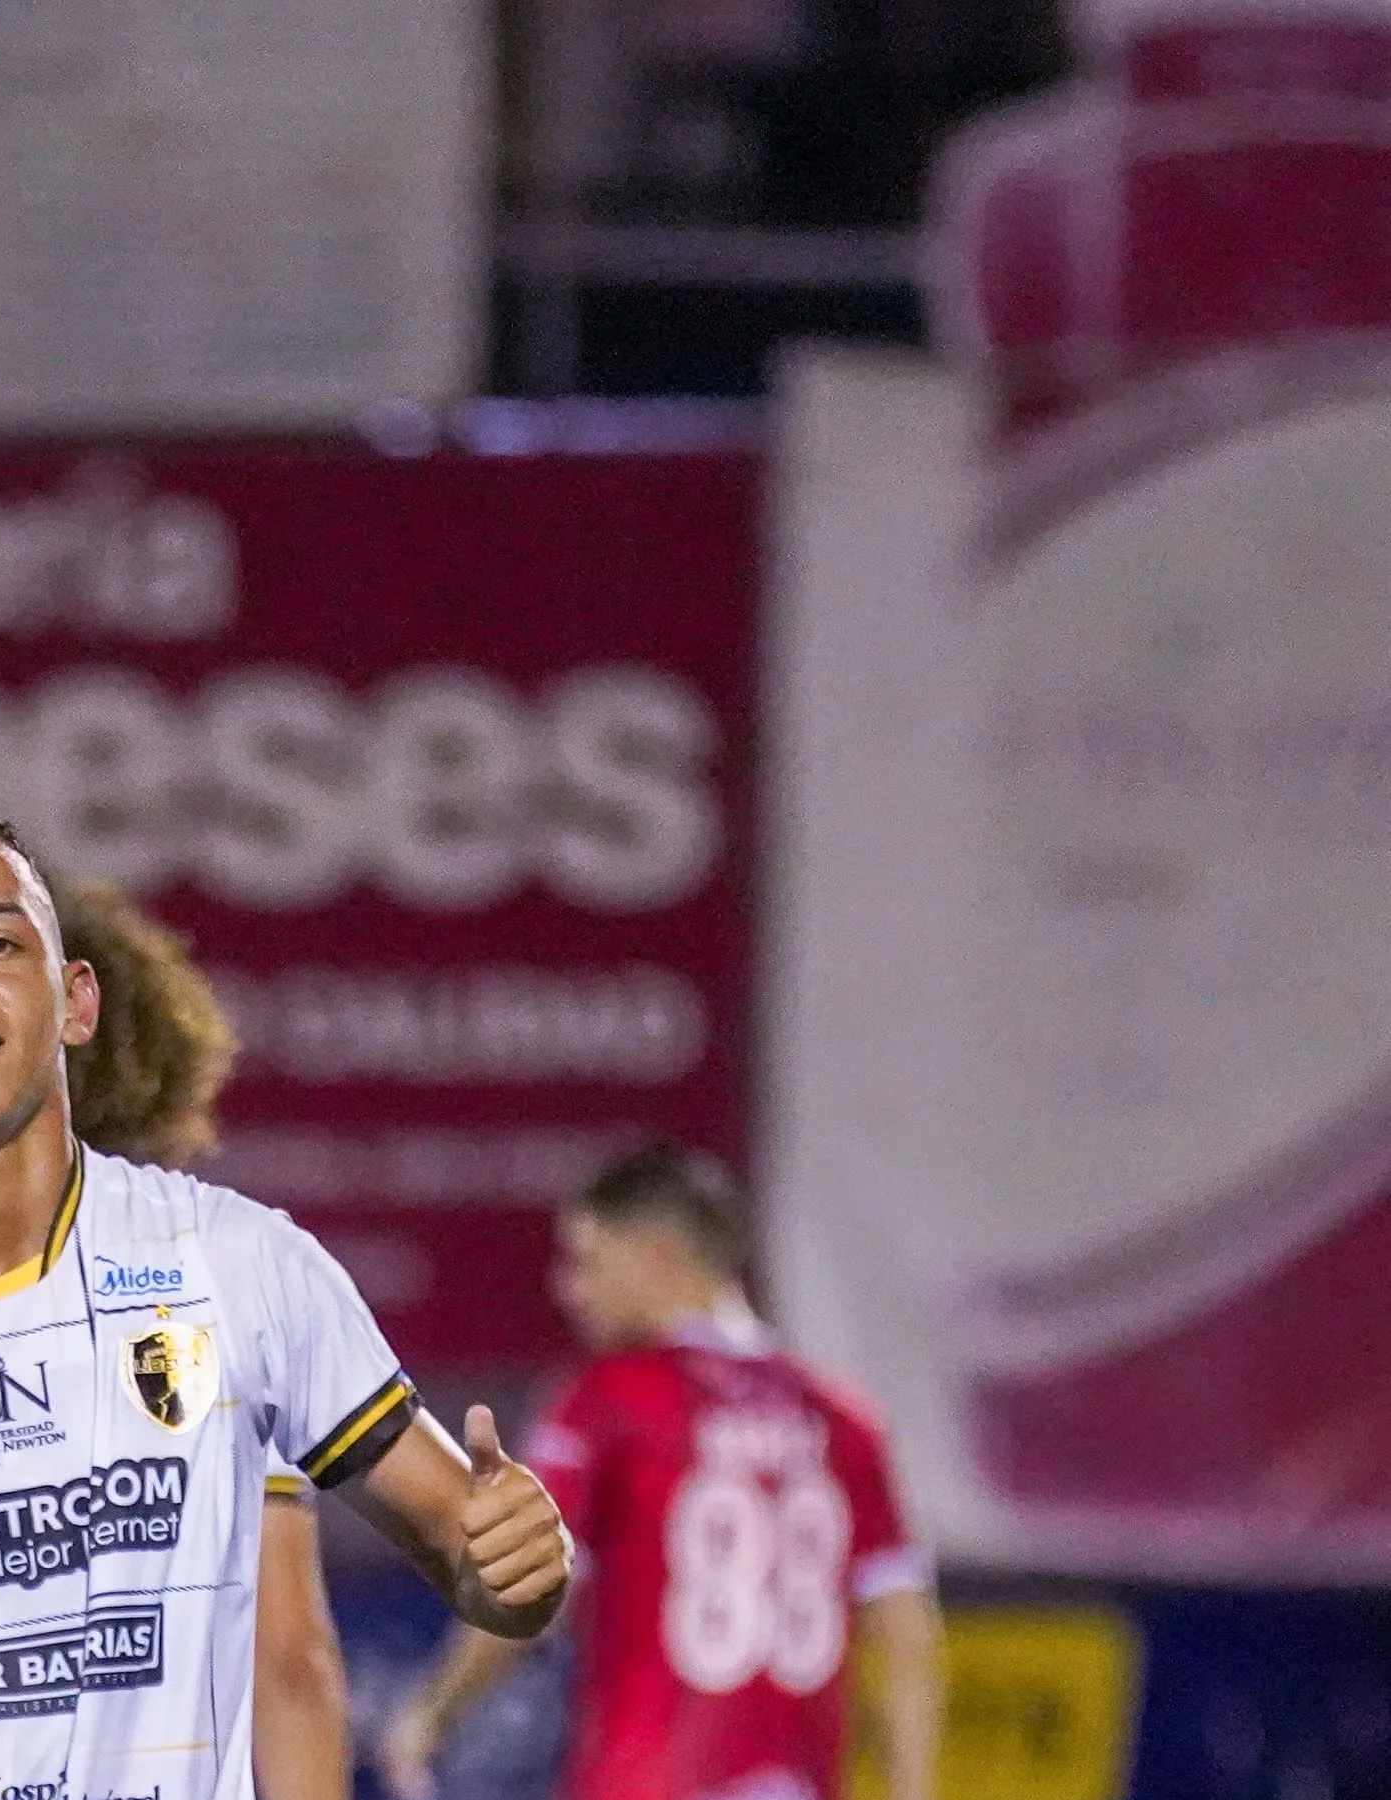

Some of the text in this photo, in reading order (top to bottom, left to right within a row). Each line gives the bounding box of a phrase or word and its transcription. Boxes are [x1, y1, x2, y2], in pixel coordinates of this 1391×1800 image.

[98, 1261, 182, 1293] Midea
[3, 1432, 66, 1453] NEWTON
[81, 1511, 180, 1560] Iernet
